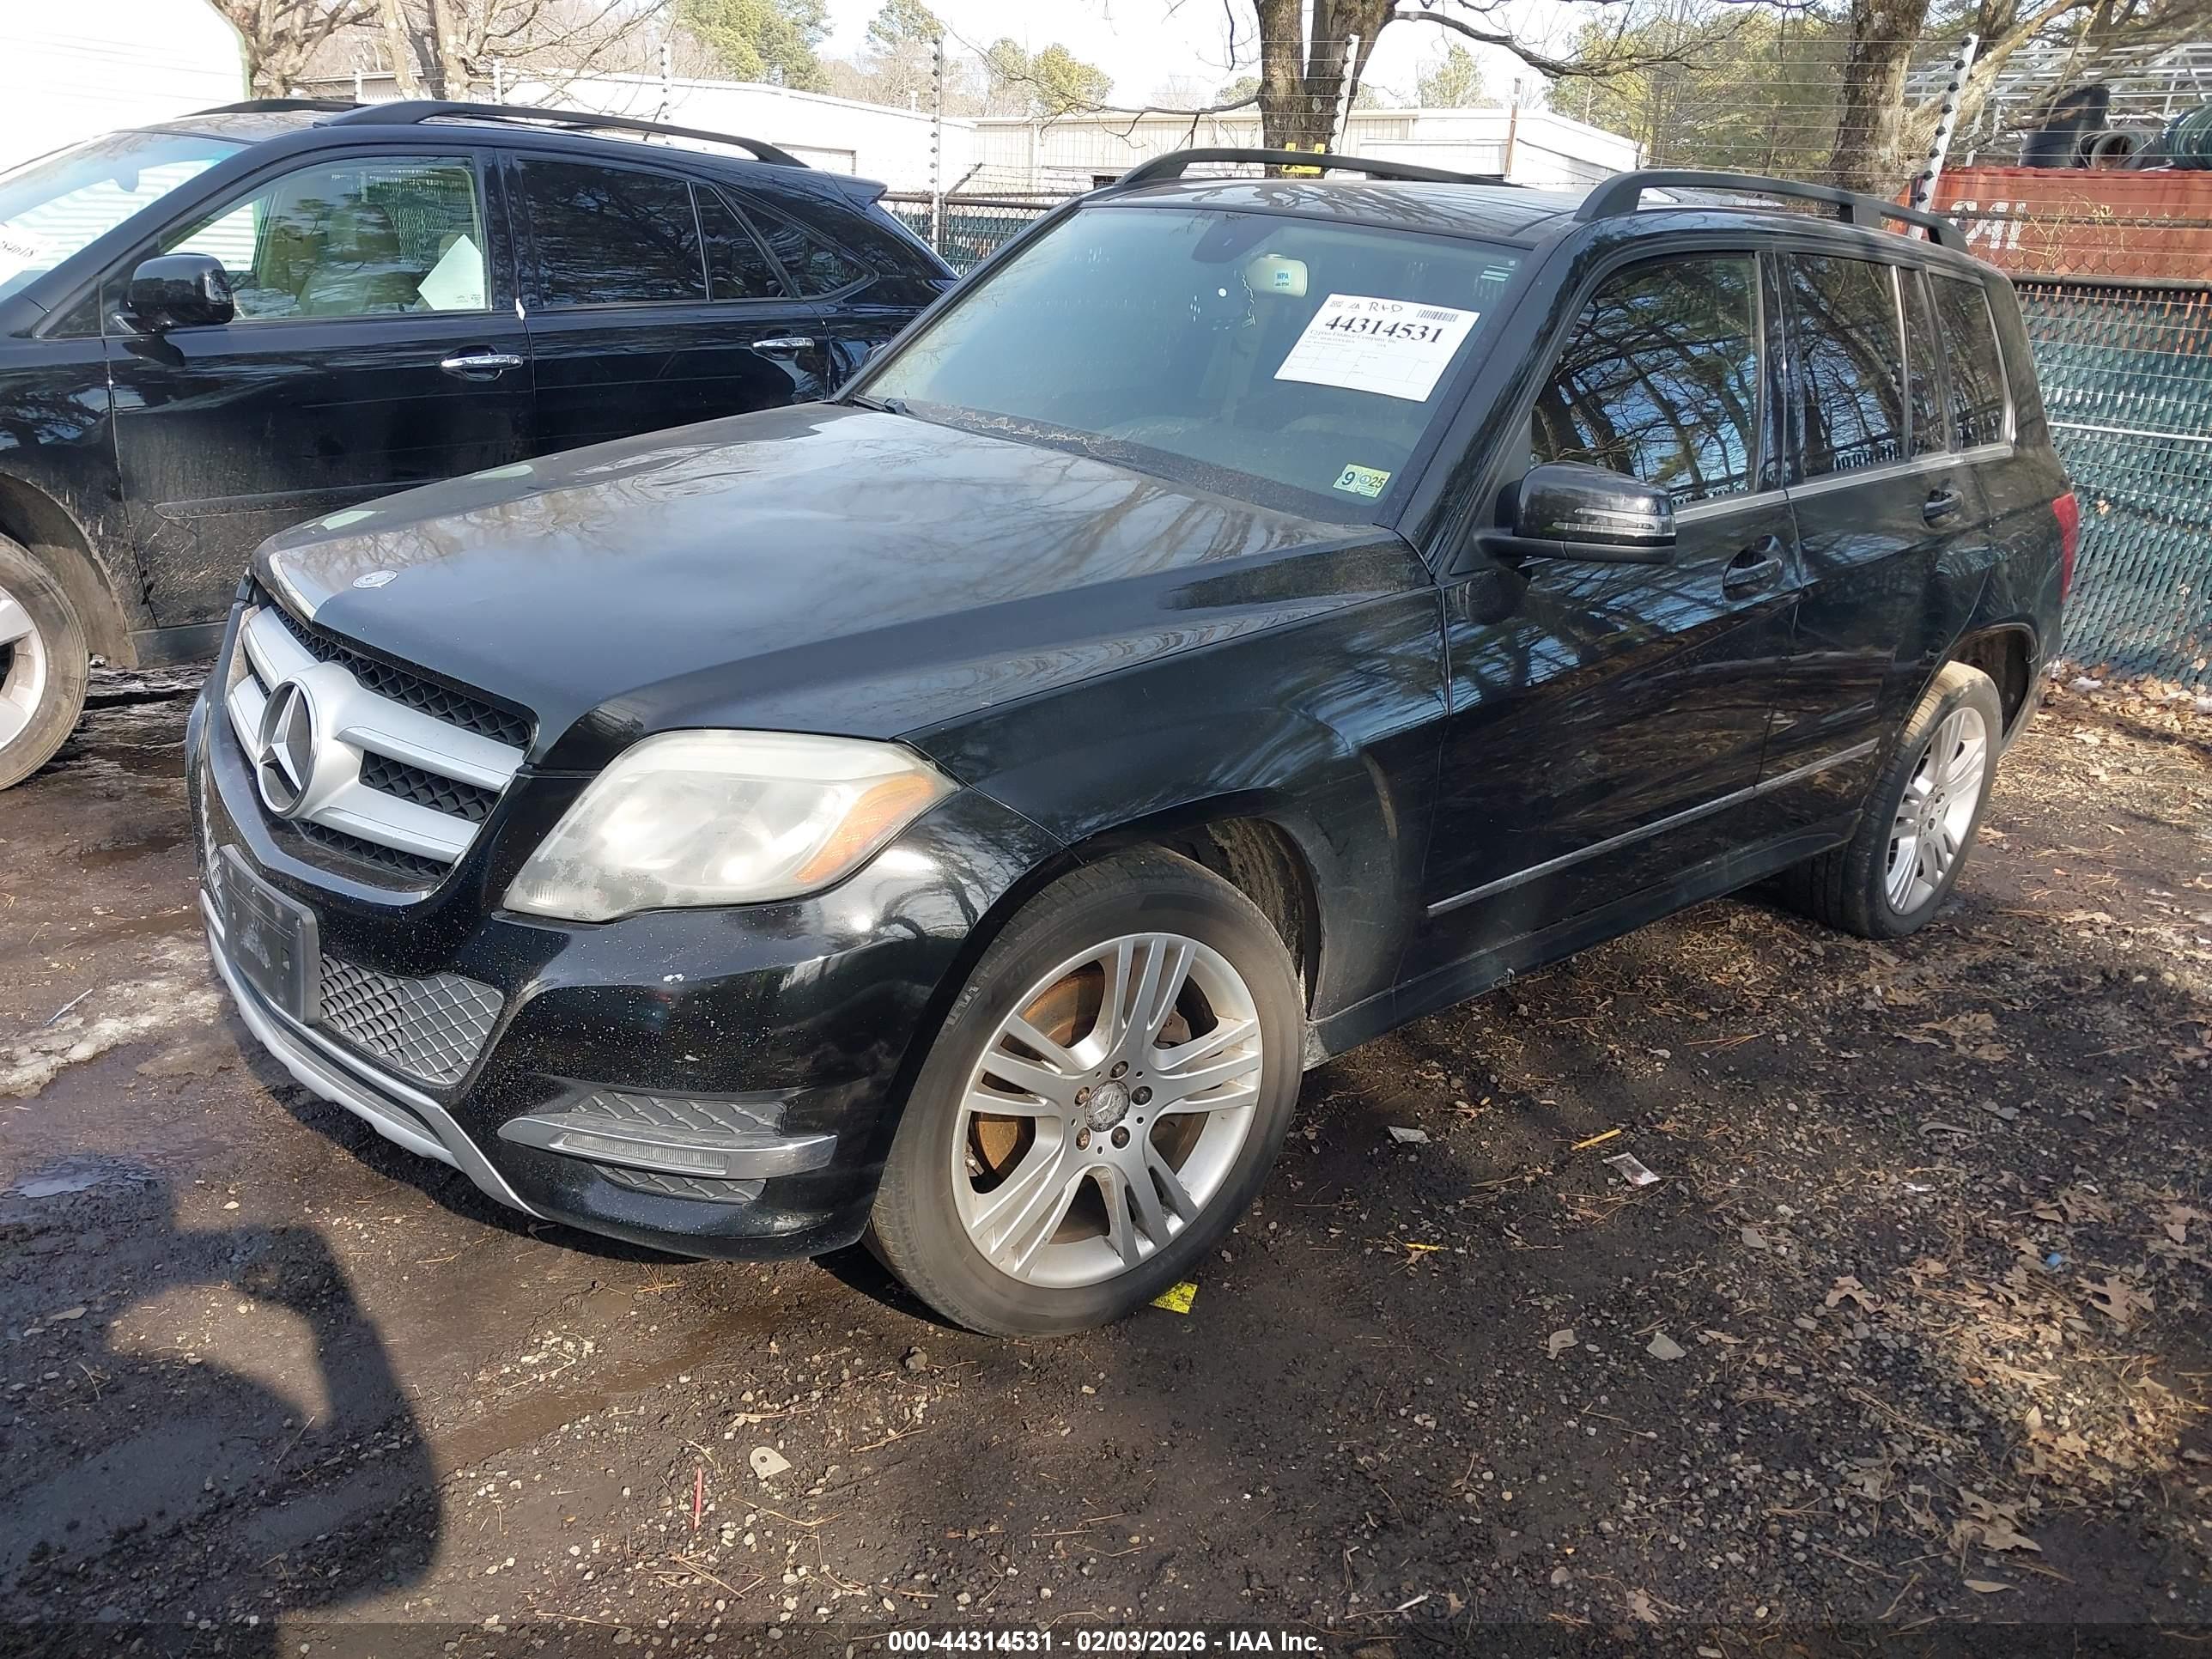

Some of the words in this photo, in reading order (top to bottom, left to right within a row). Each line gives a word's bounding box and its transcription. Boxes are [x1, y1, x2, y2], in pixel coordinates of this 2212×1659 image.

[1325, 314, 1444, 344] 44314531
[1341, 471, 1356, 486] 9
[1369, 476, 1386, 489] 25
